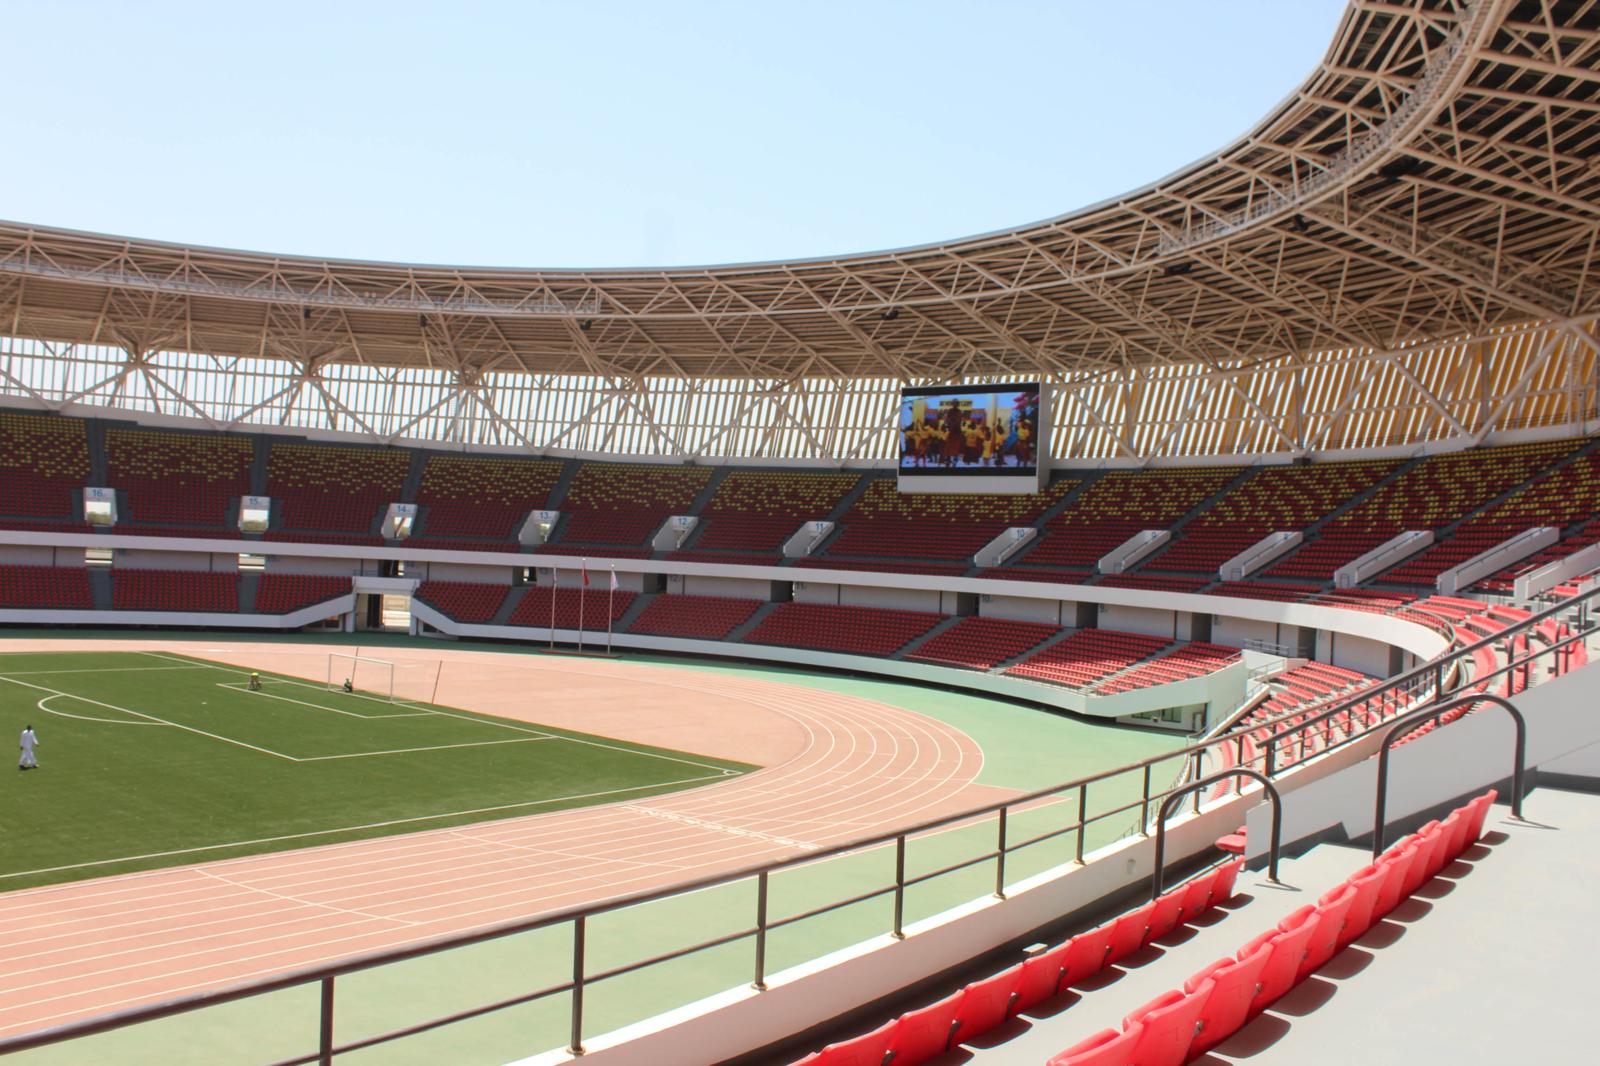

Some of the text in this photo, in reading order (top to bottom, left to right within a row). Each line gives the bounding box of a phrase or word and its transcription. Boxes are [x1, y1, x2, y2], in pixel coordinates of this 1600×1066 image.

[92, 489, 103, 497] 16
[249, 497, 258, 505] 15
[678, 517, 688, 526] 12
[1017, 529, 1025, 538] 10
